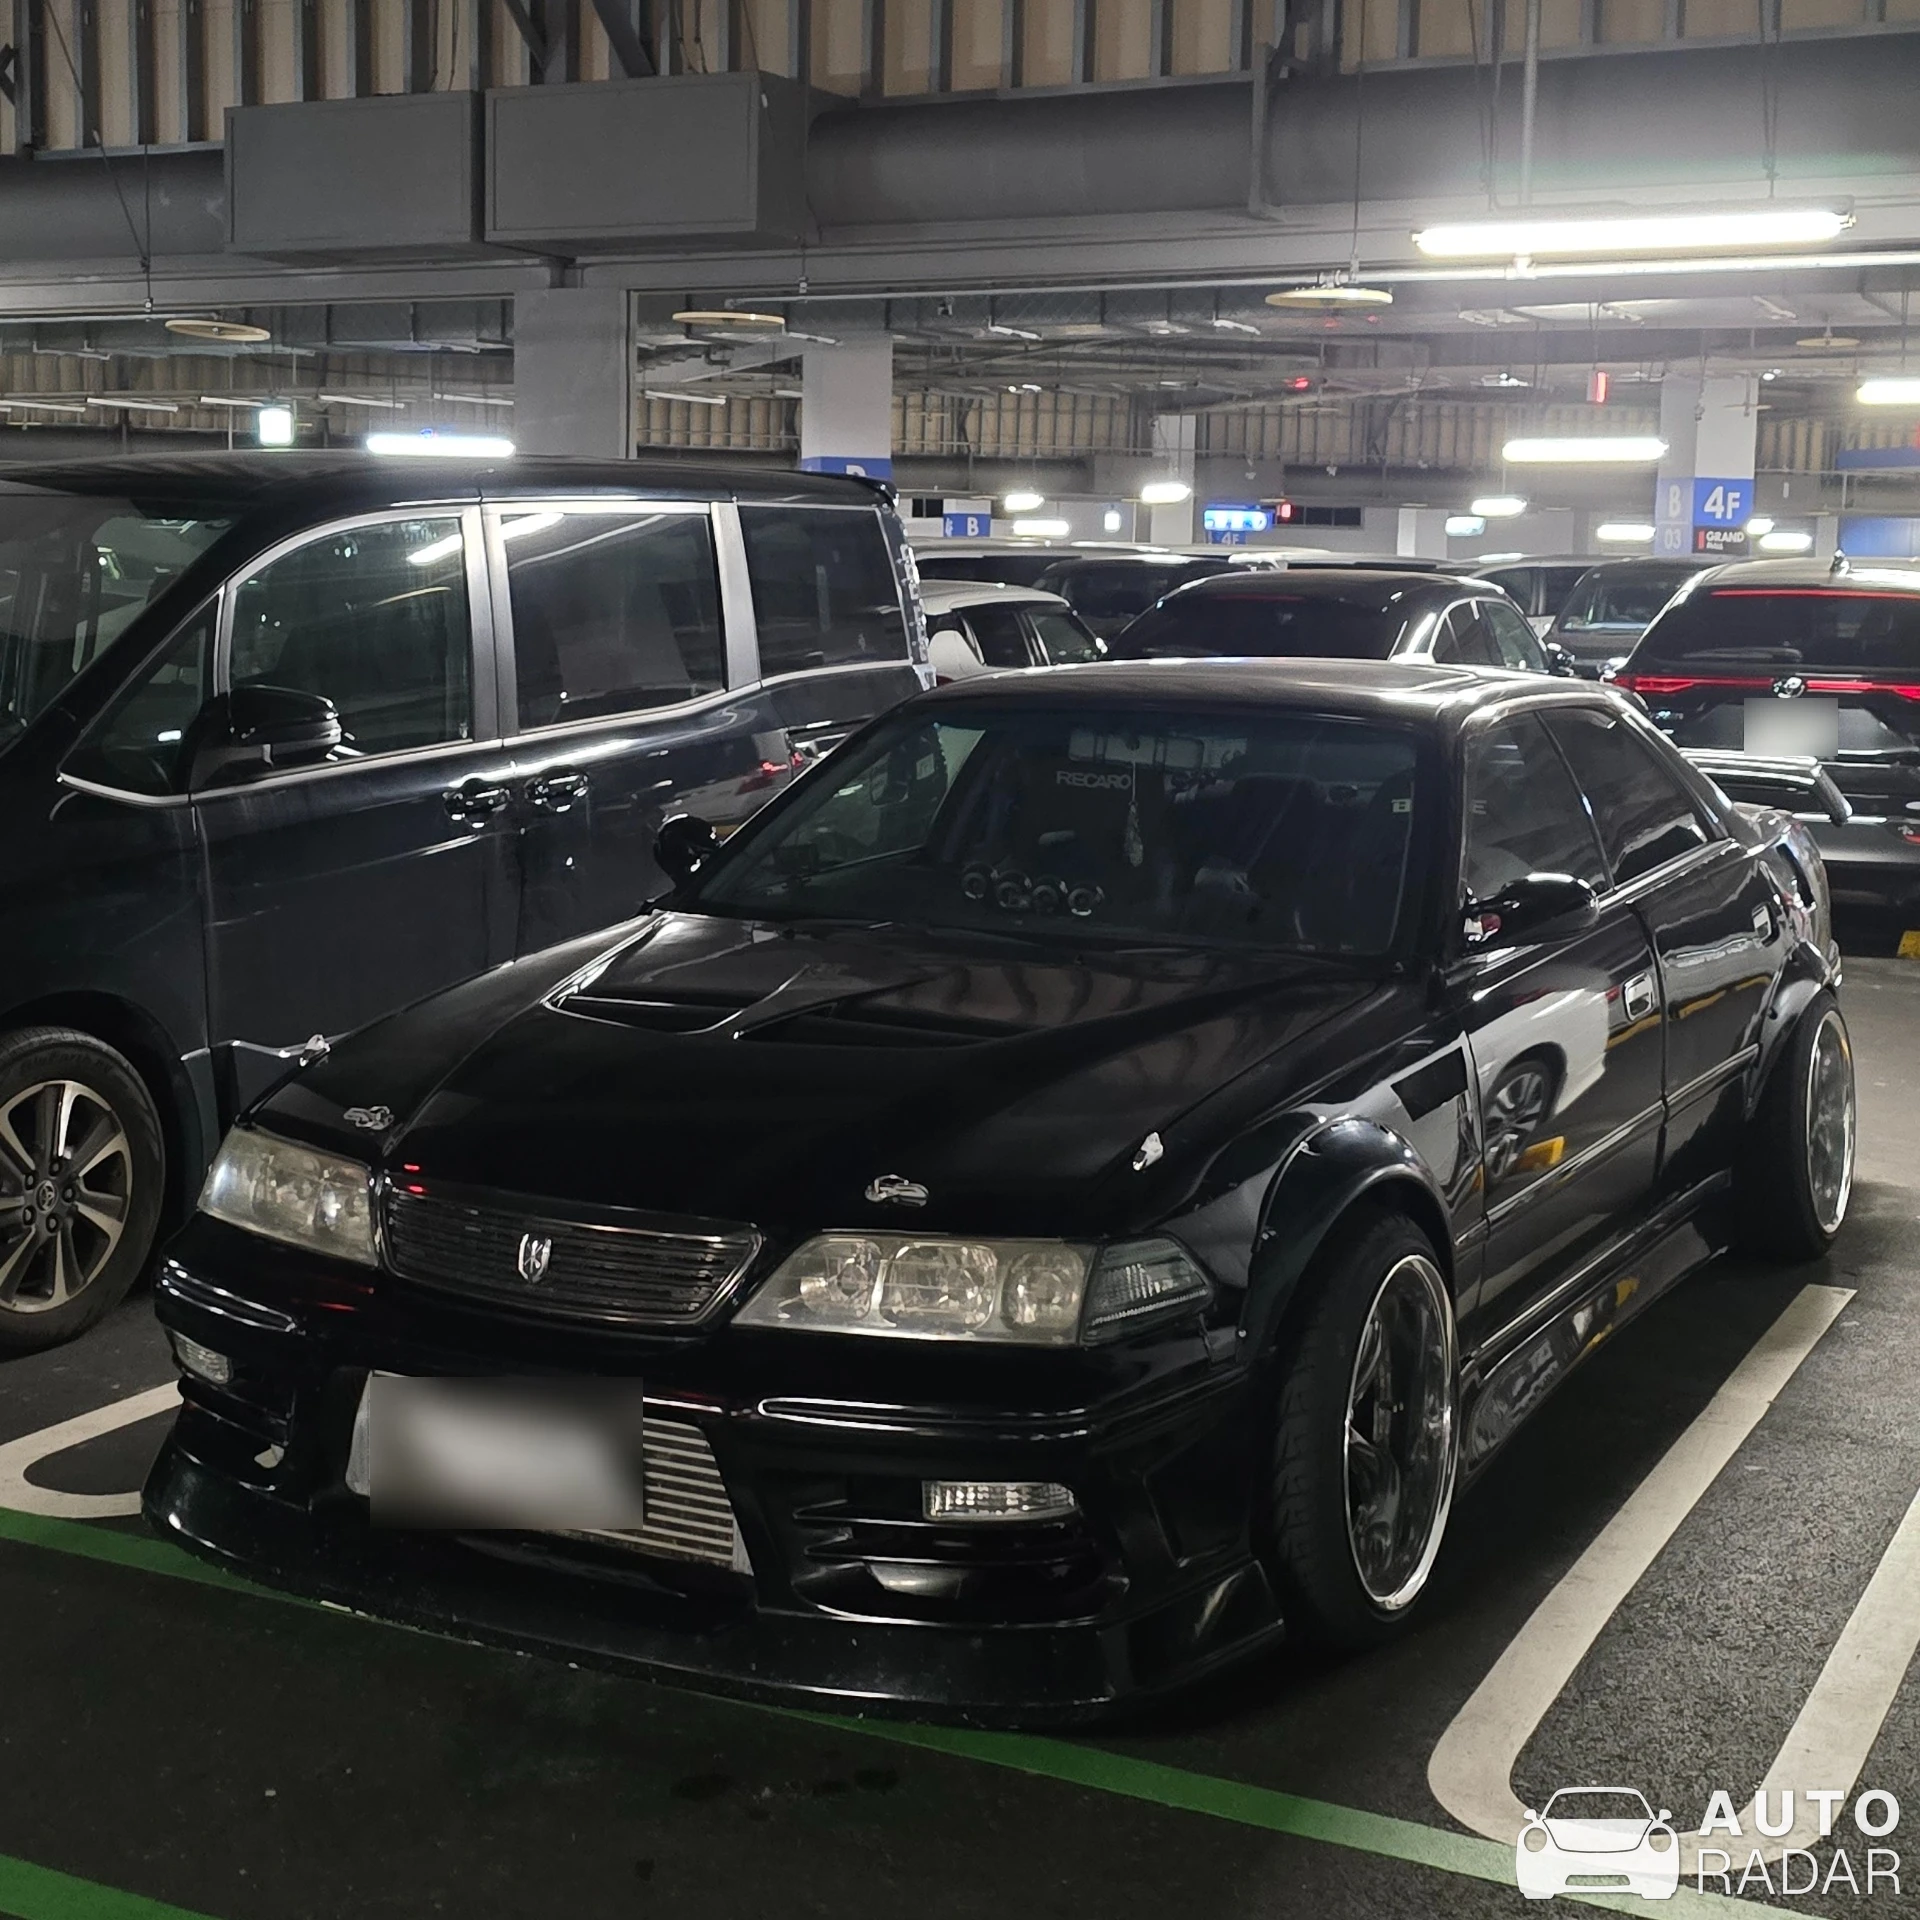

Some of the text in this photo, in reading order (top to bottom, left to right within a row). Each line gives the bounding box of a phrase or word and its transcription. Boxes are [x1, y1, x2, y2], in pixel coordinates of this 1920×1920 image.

[1667, 485, 1681, 519] B
[1703, 486, 1740, 520] 4F
[967, 516, 979, 536] B
[1664, 528, 1681, 550] 03
[1706, 531, 1745, 543] GRAND
[1056, 770, 1132, 790] RECARO
